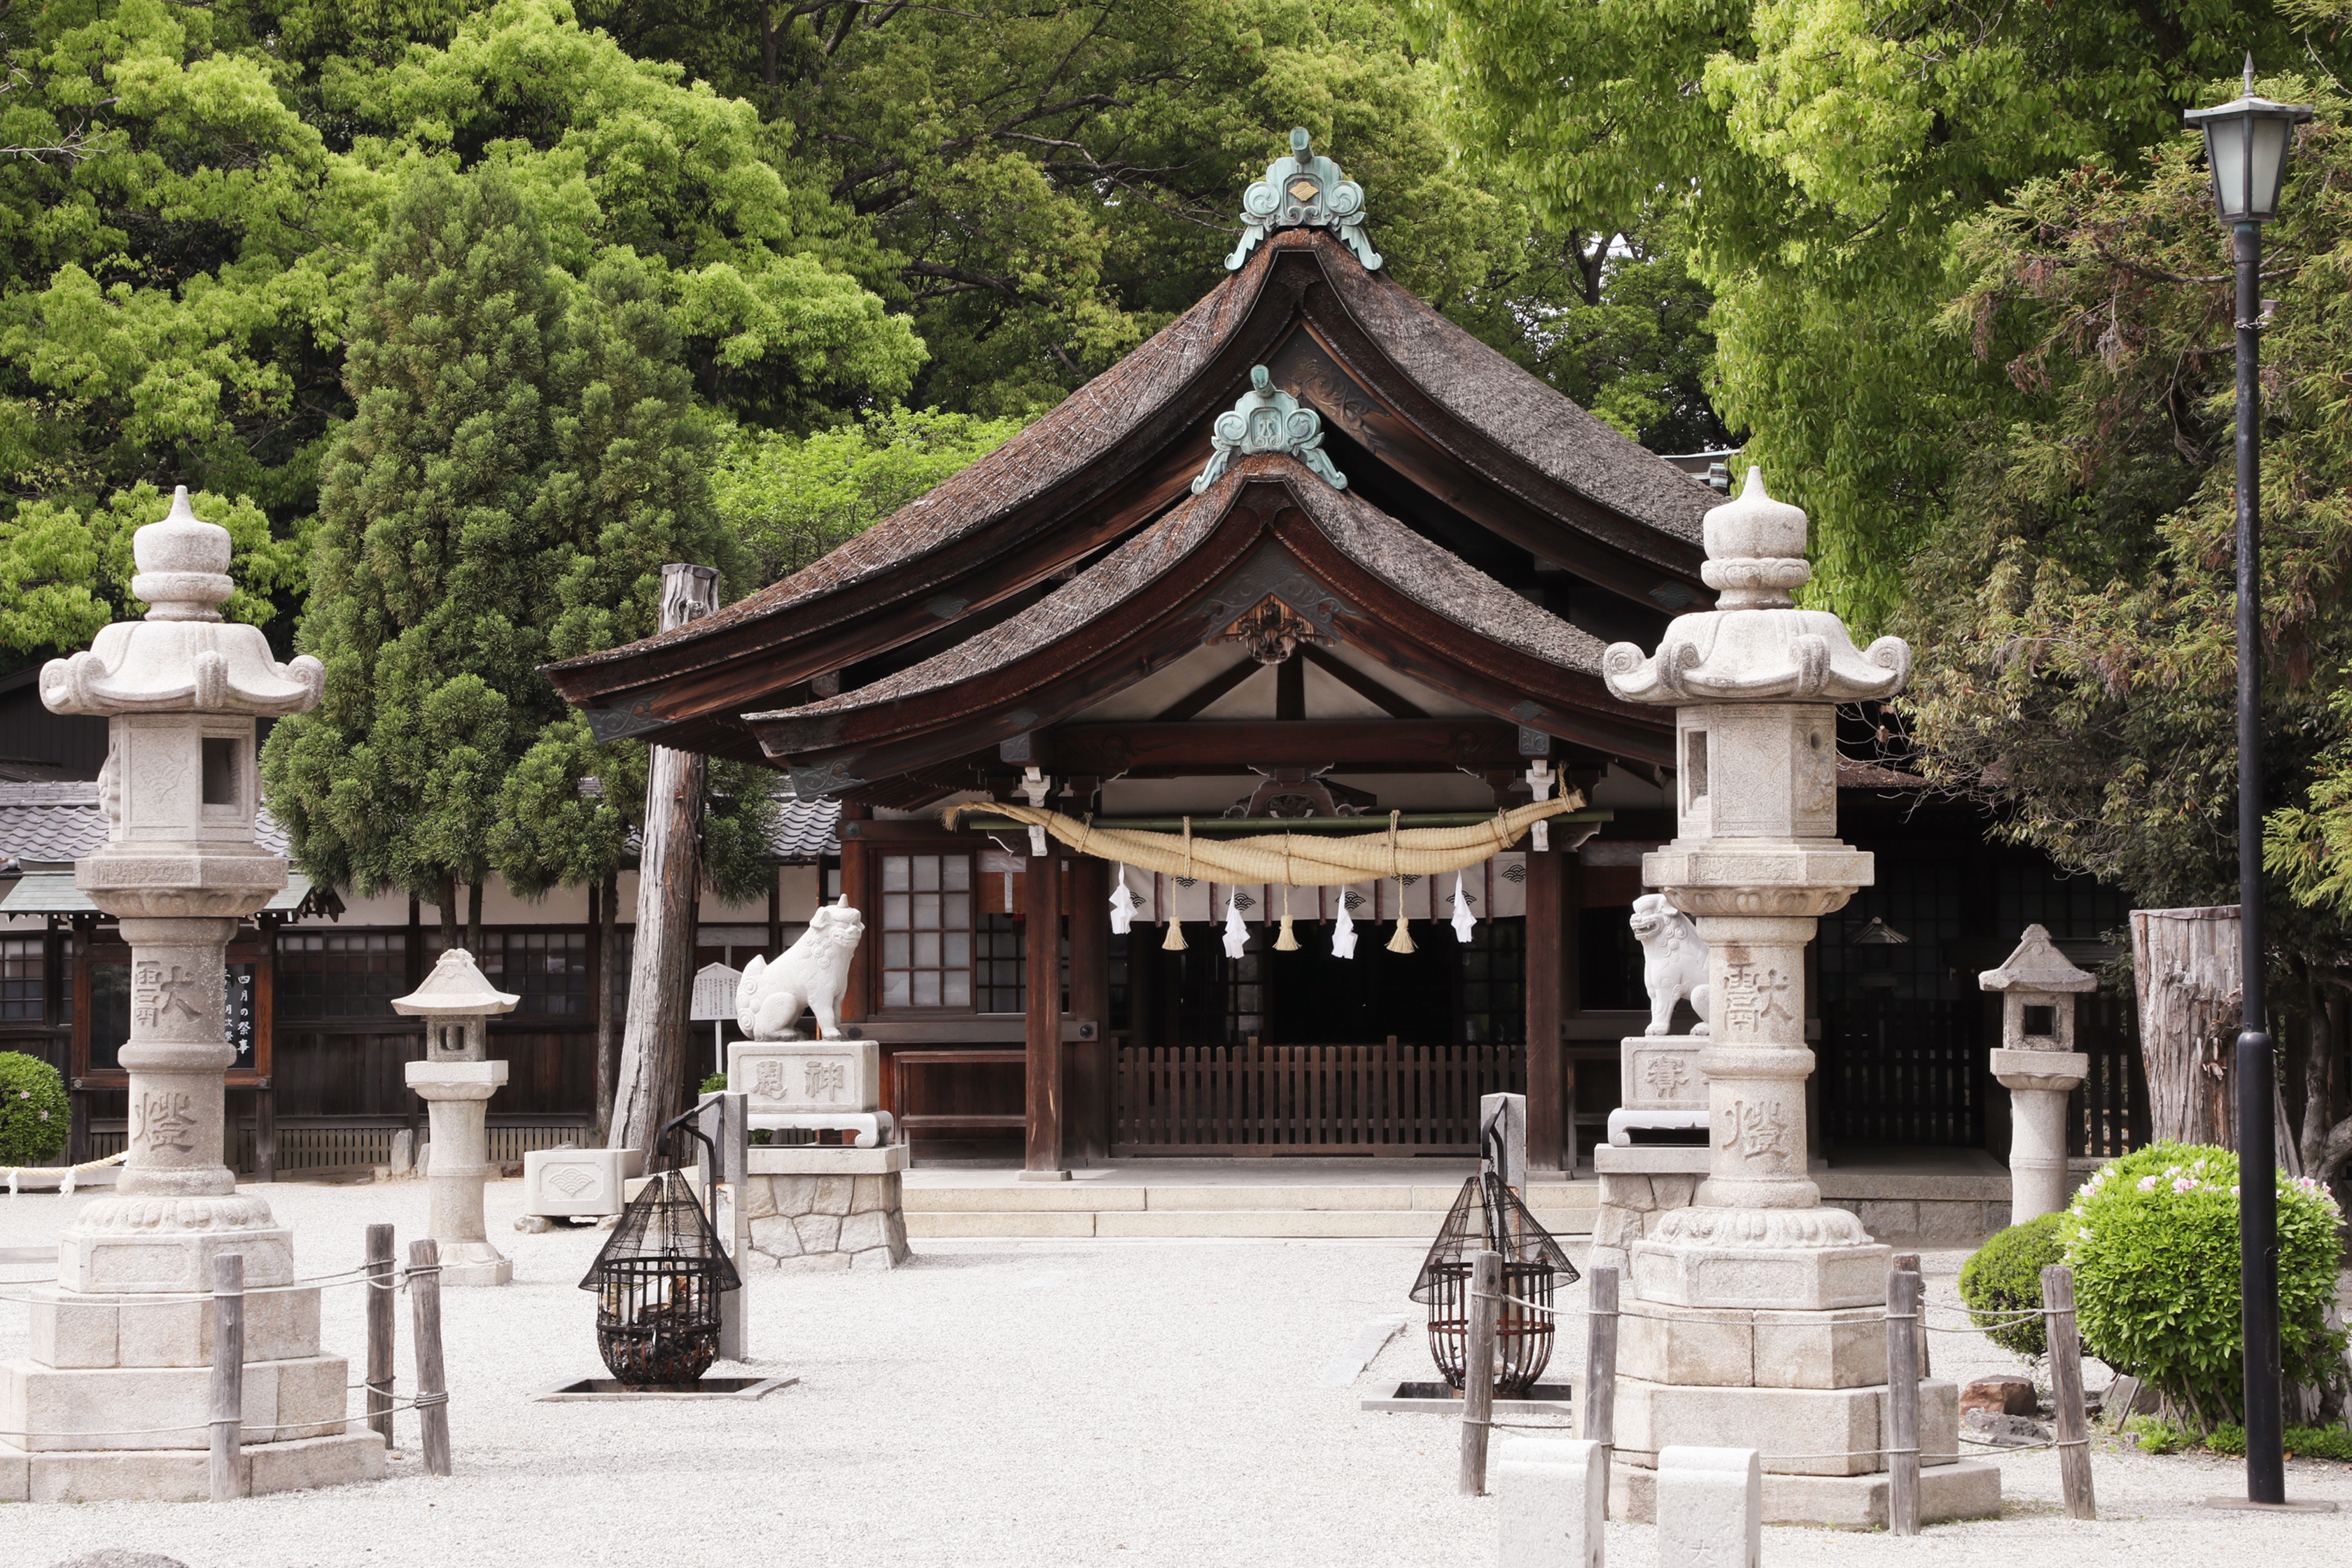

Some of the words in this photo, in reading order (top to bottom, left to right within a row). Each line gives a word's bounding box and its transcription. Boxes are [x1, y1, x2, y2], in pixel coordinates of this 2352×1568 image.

[237, 974, 251, 1055] 四月の祭事
